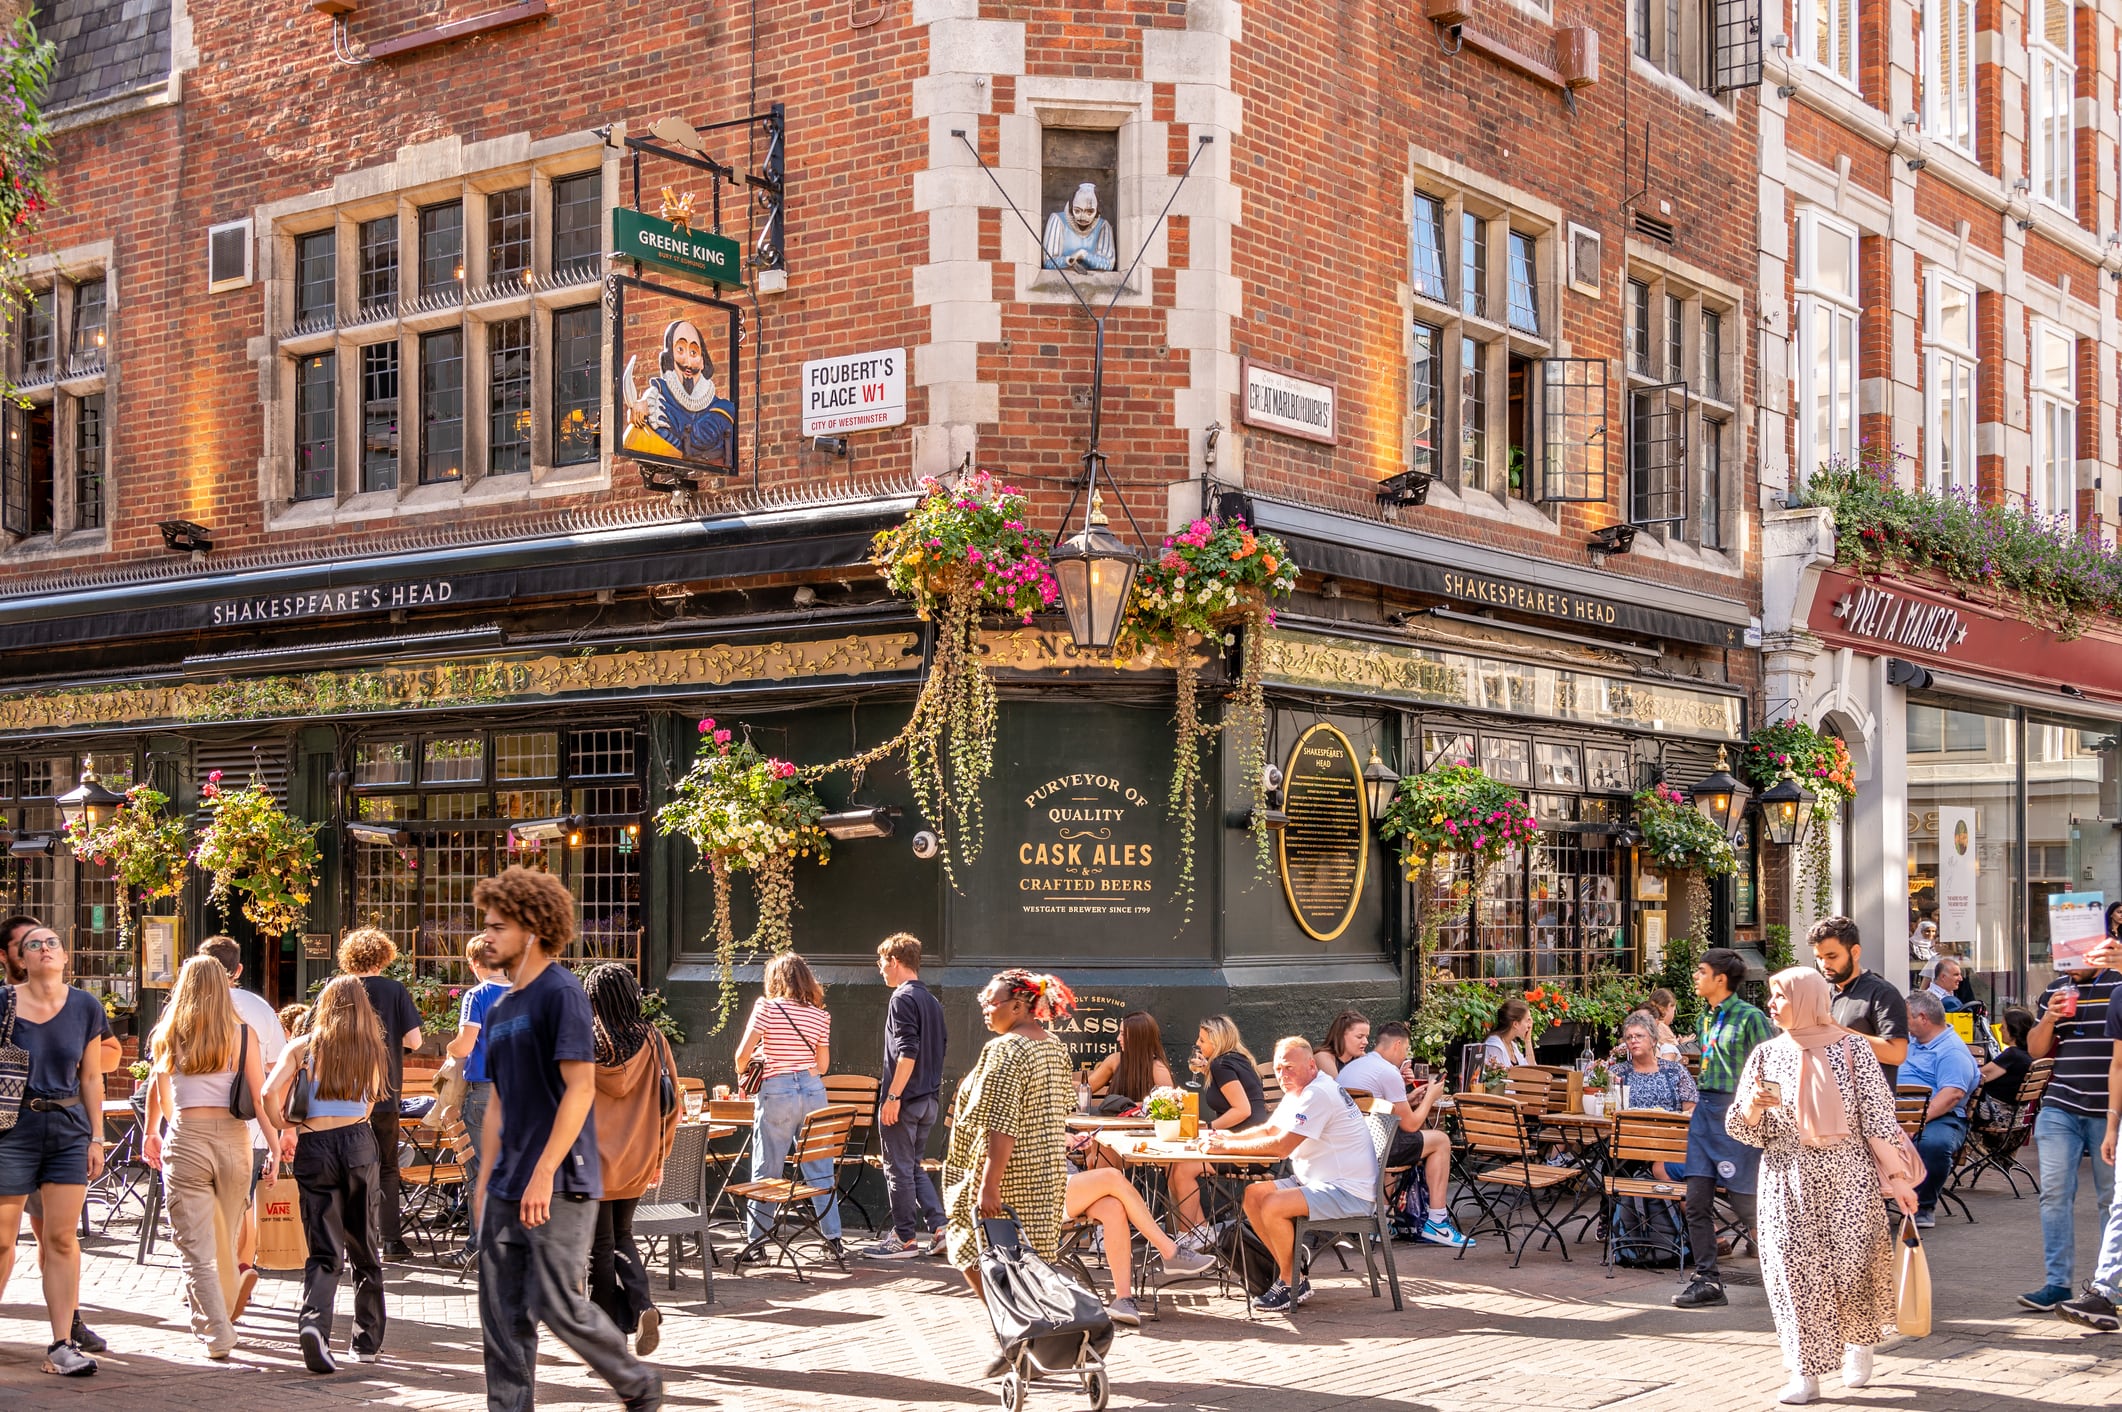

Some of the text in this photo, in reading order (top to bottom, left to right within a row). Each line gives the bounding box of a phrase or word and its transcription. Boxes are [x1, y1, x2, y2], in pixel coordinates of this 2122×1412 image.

[638, 230, 725, 266] GREENE KING
[811, 357, 894, 387] FOUBERT'S
[811, 382, 885, 410] PLACE W1
[811, 412, 888, 431] CITY OF WESTMINSTER
[214, 581, 453, 625] SHAKESPEARE'S HEAD
[1444, 573, 1616, 624] SHAKESPEARE'S HEAD
[1849, 586, 1958, 654] PRET A MANGER
[1303, 747, 1344, 758] SHAKESPEARE'S
[1315, 759, 1331, 768] HEAD
[1024, 773, 1149, 809] PURVEYOR OF
[1048, 808, 1125, 823] QUALITY
[1019, 842, 1153, 867] CASK ALES
[1081, 866, 1090, 876] &
[1019, 878, 1152, 892] CRAFTED BEERS
[1023, 905, 1151, 914] WESTGATE BREWERY SINCE 1799
[1036, 1016, 1123, 1035] LASS
[266, 1202, 291, 1215] VANS
